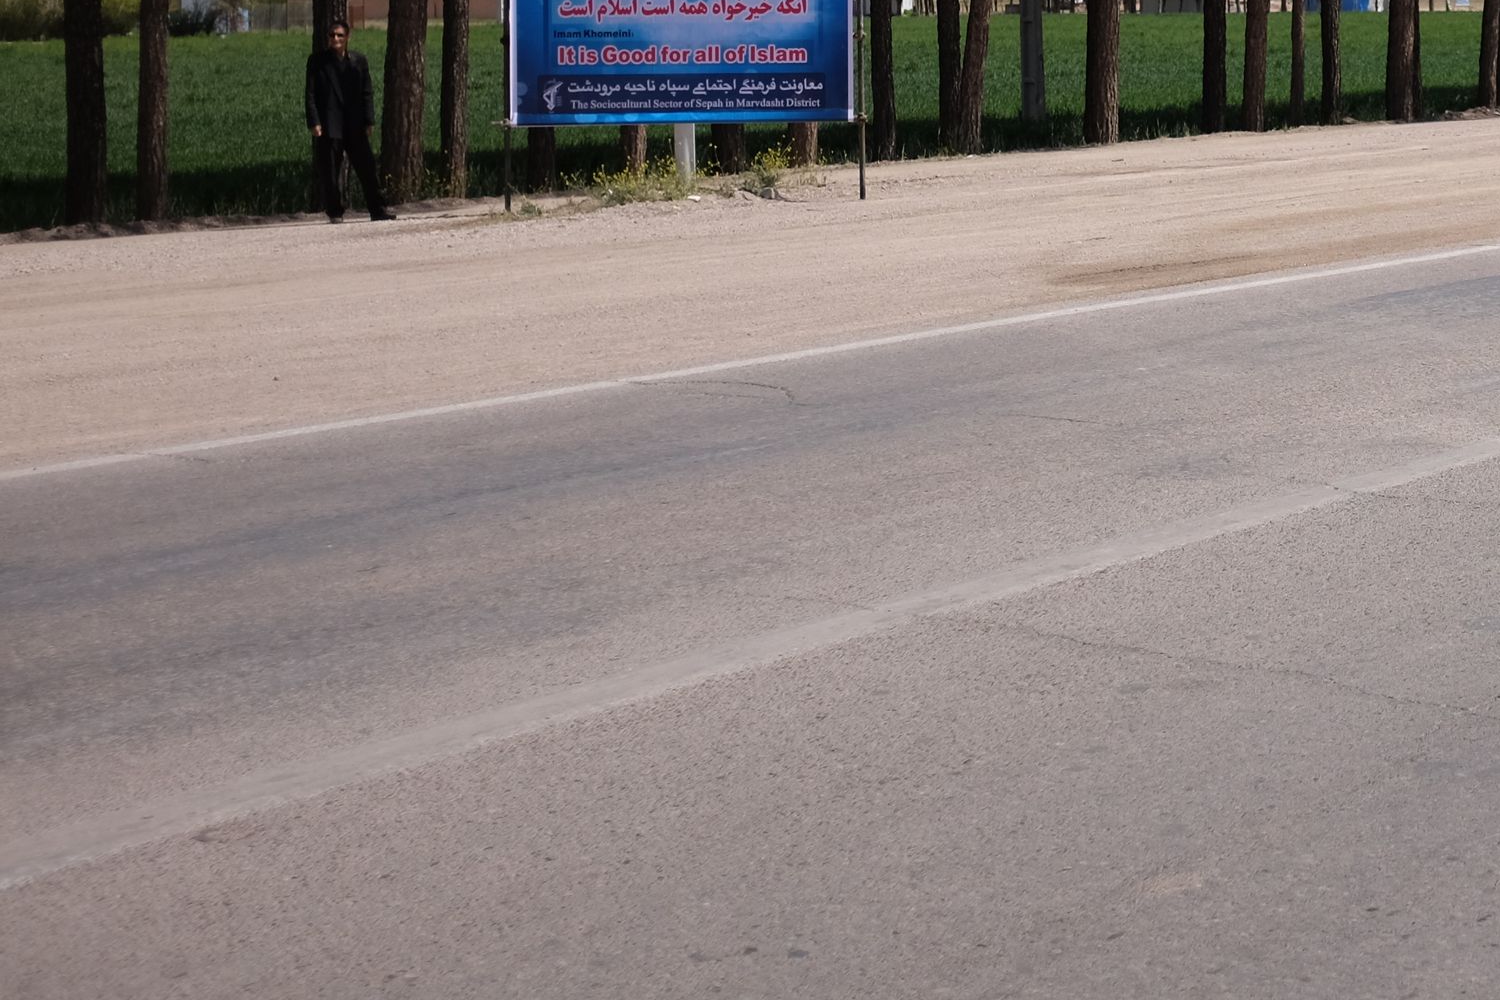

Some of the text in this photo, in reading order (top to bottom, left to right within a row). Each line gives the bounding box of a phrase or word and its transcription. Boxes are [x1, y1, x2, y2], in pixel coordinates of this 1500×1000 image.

[679, 1, 708, 15] همه
[553, 29, 582, 39] Imam
[559, 45, 806, 64] It is Good for all of Islam
[567, 80, 621, 96] مرودشت
[624, 80, 656, 95] ناحیه
[659, 79, 690, 97] سپاه
[779, 78, 823, 94] معاونت
[570, 97, 821, 110] The Sociocultural Sector of Sepah in Marvdasht District
